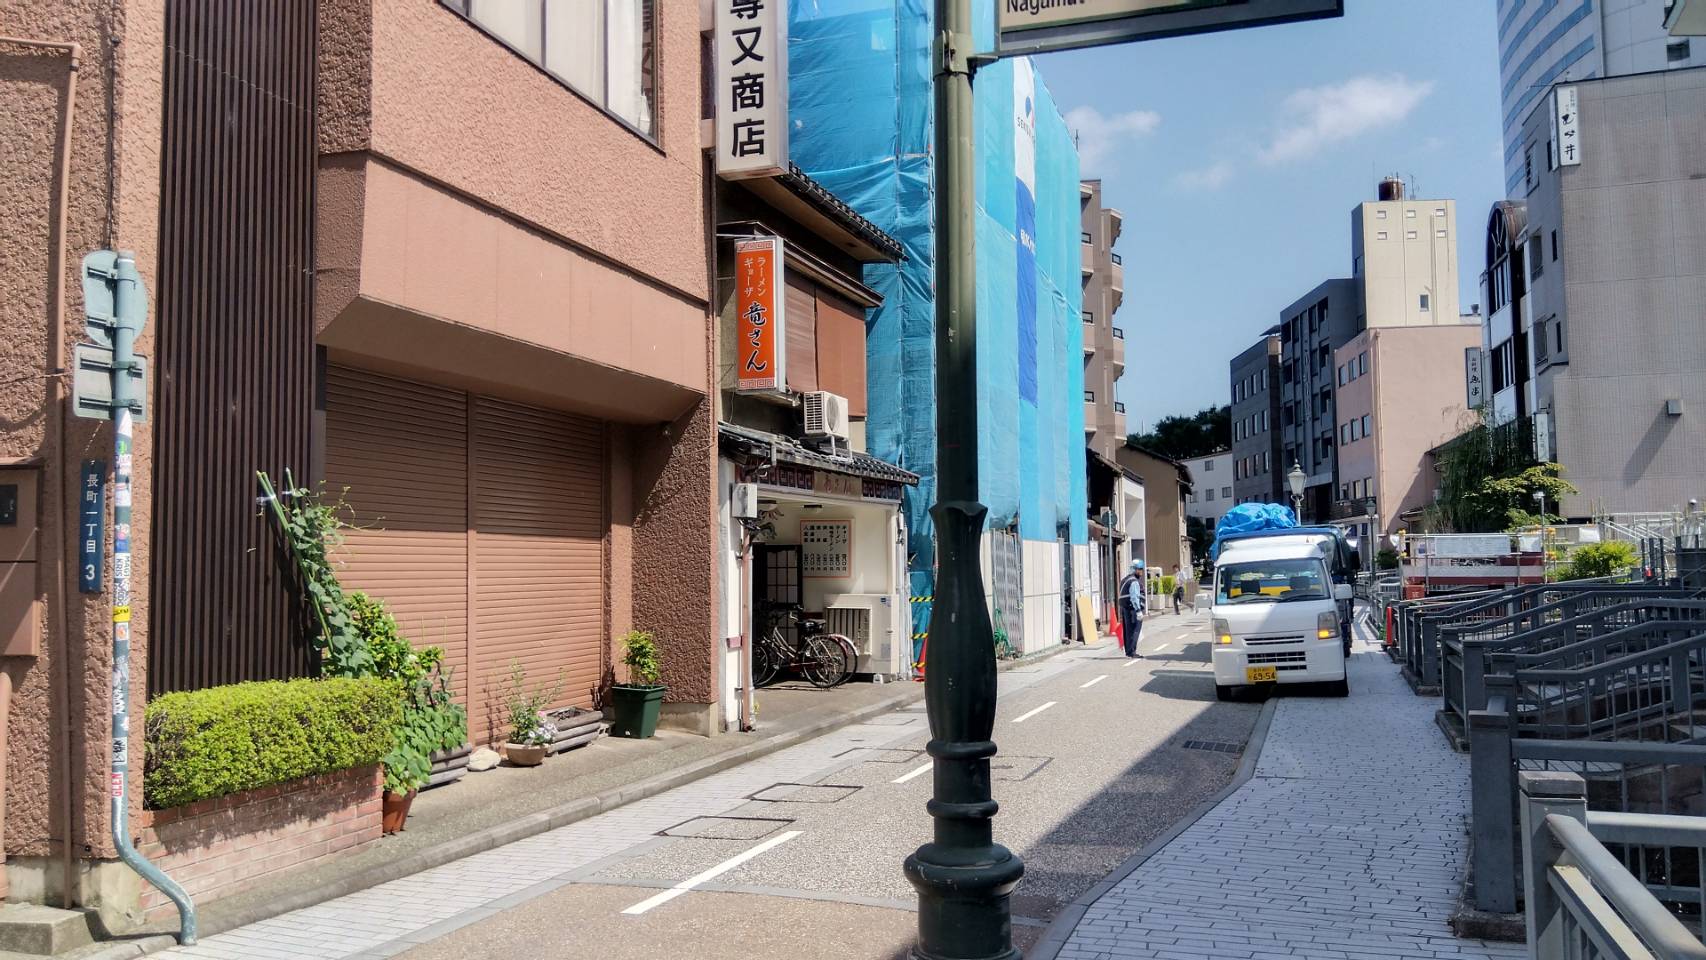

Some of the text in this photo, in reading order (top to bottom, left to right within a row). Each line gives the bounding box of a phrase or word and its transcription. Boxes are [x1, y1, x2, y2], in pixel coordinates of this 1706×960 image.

[1007, 0, 1085, 15] Nagama
[744, 257, 754, 298] ギョーザ
[756, 256, 767, 297] ラーメン
[743, 301, 767, 372] 竜さん
[85, 473, 98, 580] 長町一丁目 3
